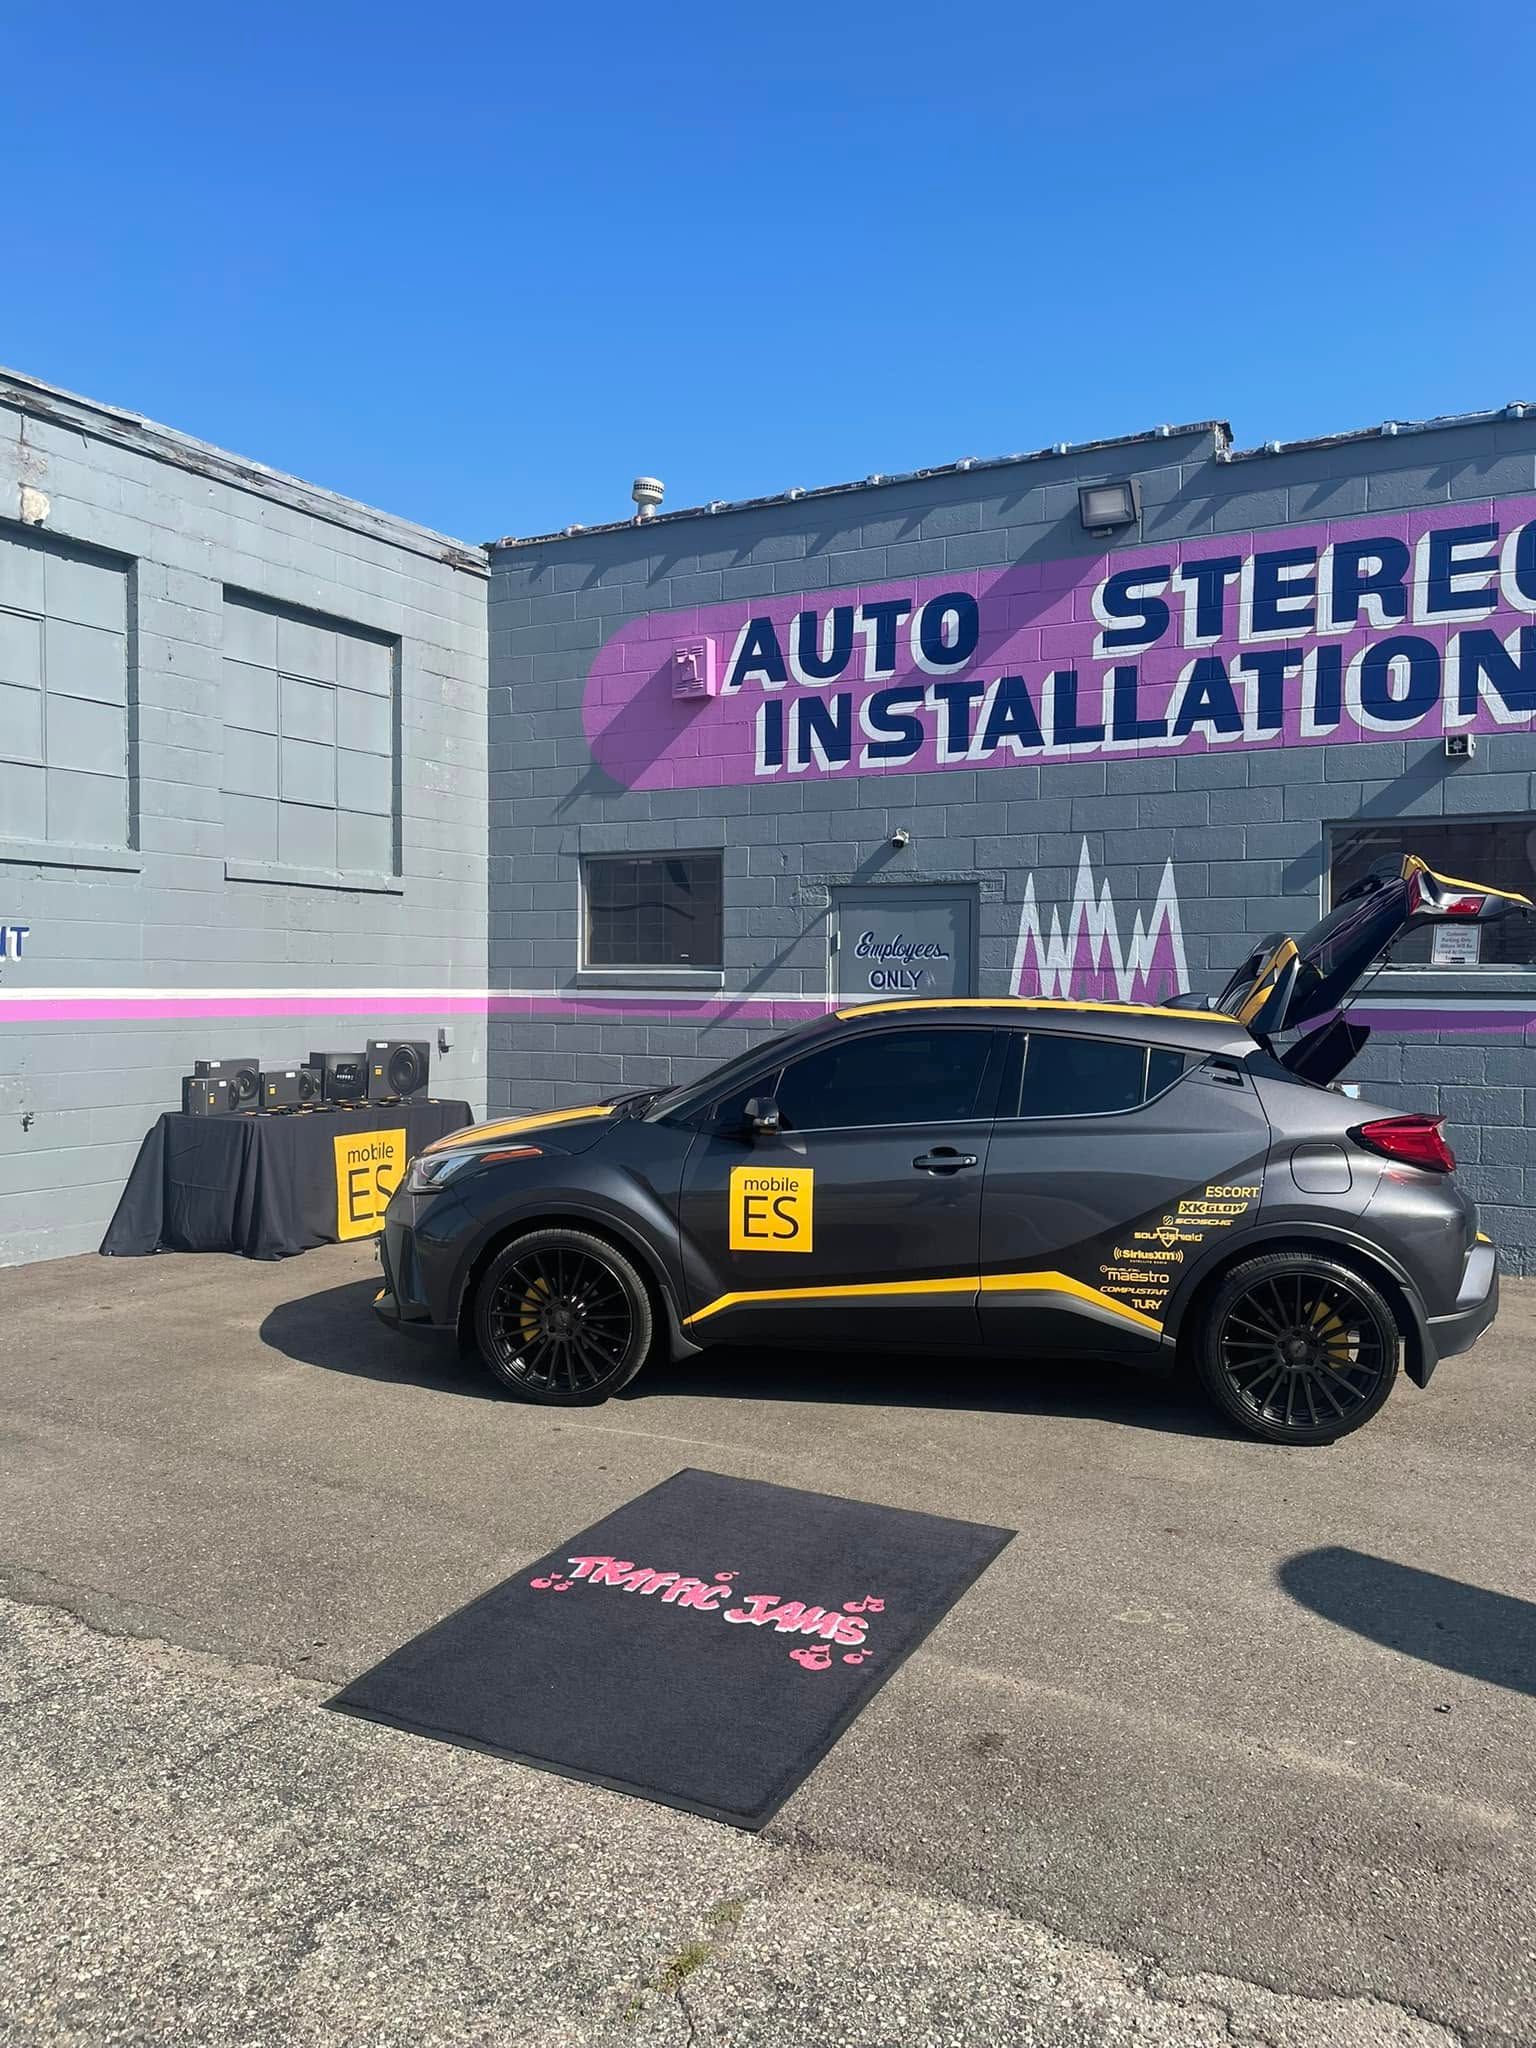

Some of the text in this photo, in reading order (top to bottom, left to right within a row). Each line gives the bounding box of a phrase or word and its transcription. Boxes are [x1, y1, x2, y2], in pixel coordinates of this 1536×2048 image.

[720, 592, 979, 696] AUTO
[854, 930, 950, 965] Employees
[868, 969, 924, 990] ONLY
[347, 1142, 394, 1165] mobile
[348, 1164, 393, 1223] ES
[743, 1177, 799, 1192] mobile
[1205, 1186, 1259, 1198] ESCORT
[743, 1195, 799, 1239] ES
[1107, 1270, 1170, 1284] maestro
[1100, 1286, 1170, 1296] COMPUSTAR
[1131, 1299, 1163, 1310] TURY
[567, 1555, 869, 1646] TRAFFIC JAMS
